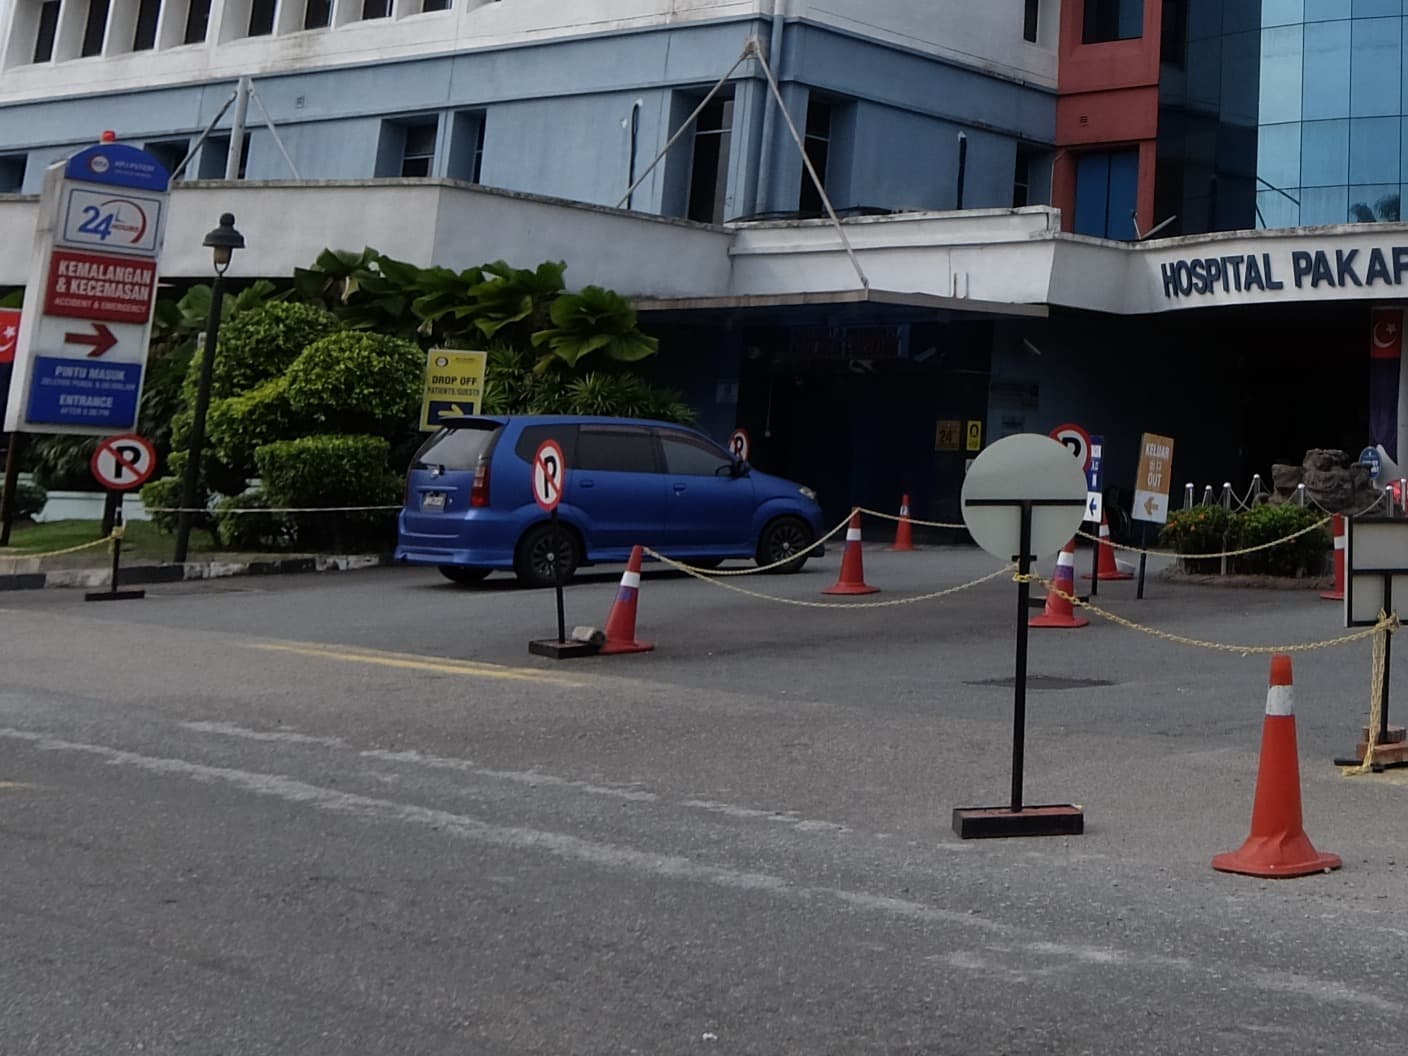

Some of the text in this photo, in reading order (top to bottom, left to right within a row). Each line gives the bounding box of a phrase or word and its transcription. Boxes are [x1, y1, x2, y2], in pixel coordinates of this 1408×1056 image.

[78, 205, 114, 241] 24
[58, 260, 152, 284] KEMALANGAN
[1160, 252, 1284, 298] HOSPITAL
[56, 277, 149, 301] & KECEMASAN
[55, 366, 125, 380] PINTU MASUK
[432, 376, 477, 385] DROP OFF
[59, 395, 113, 408] ENTRANCE
[1147, 472, 1162, 488] OUT
